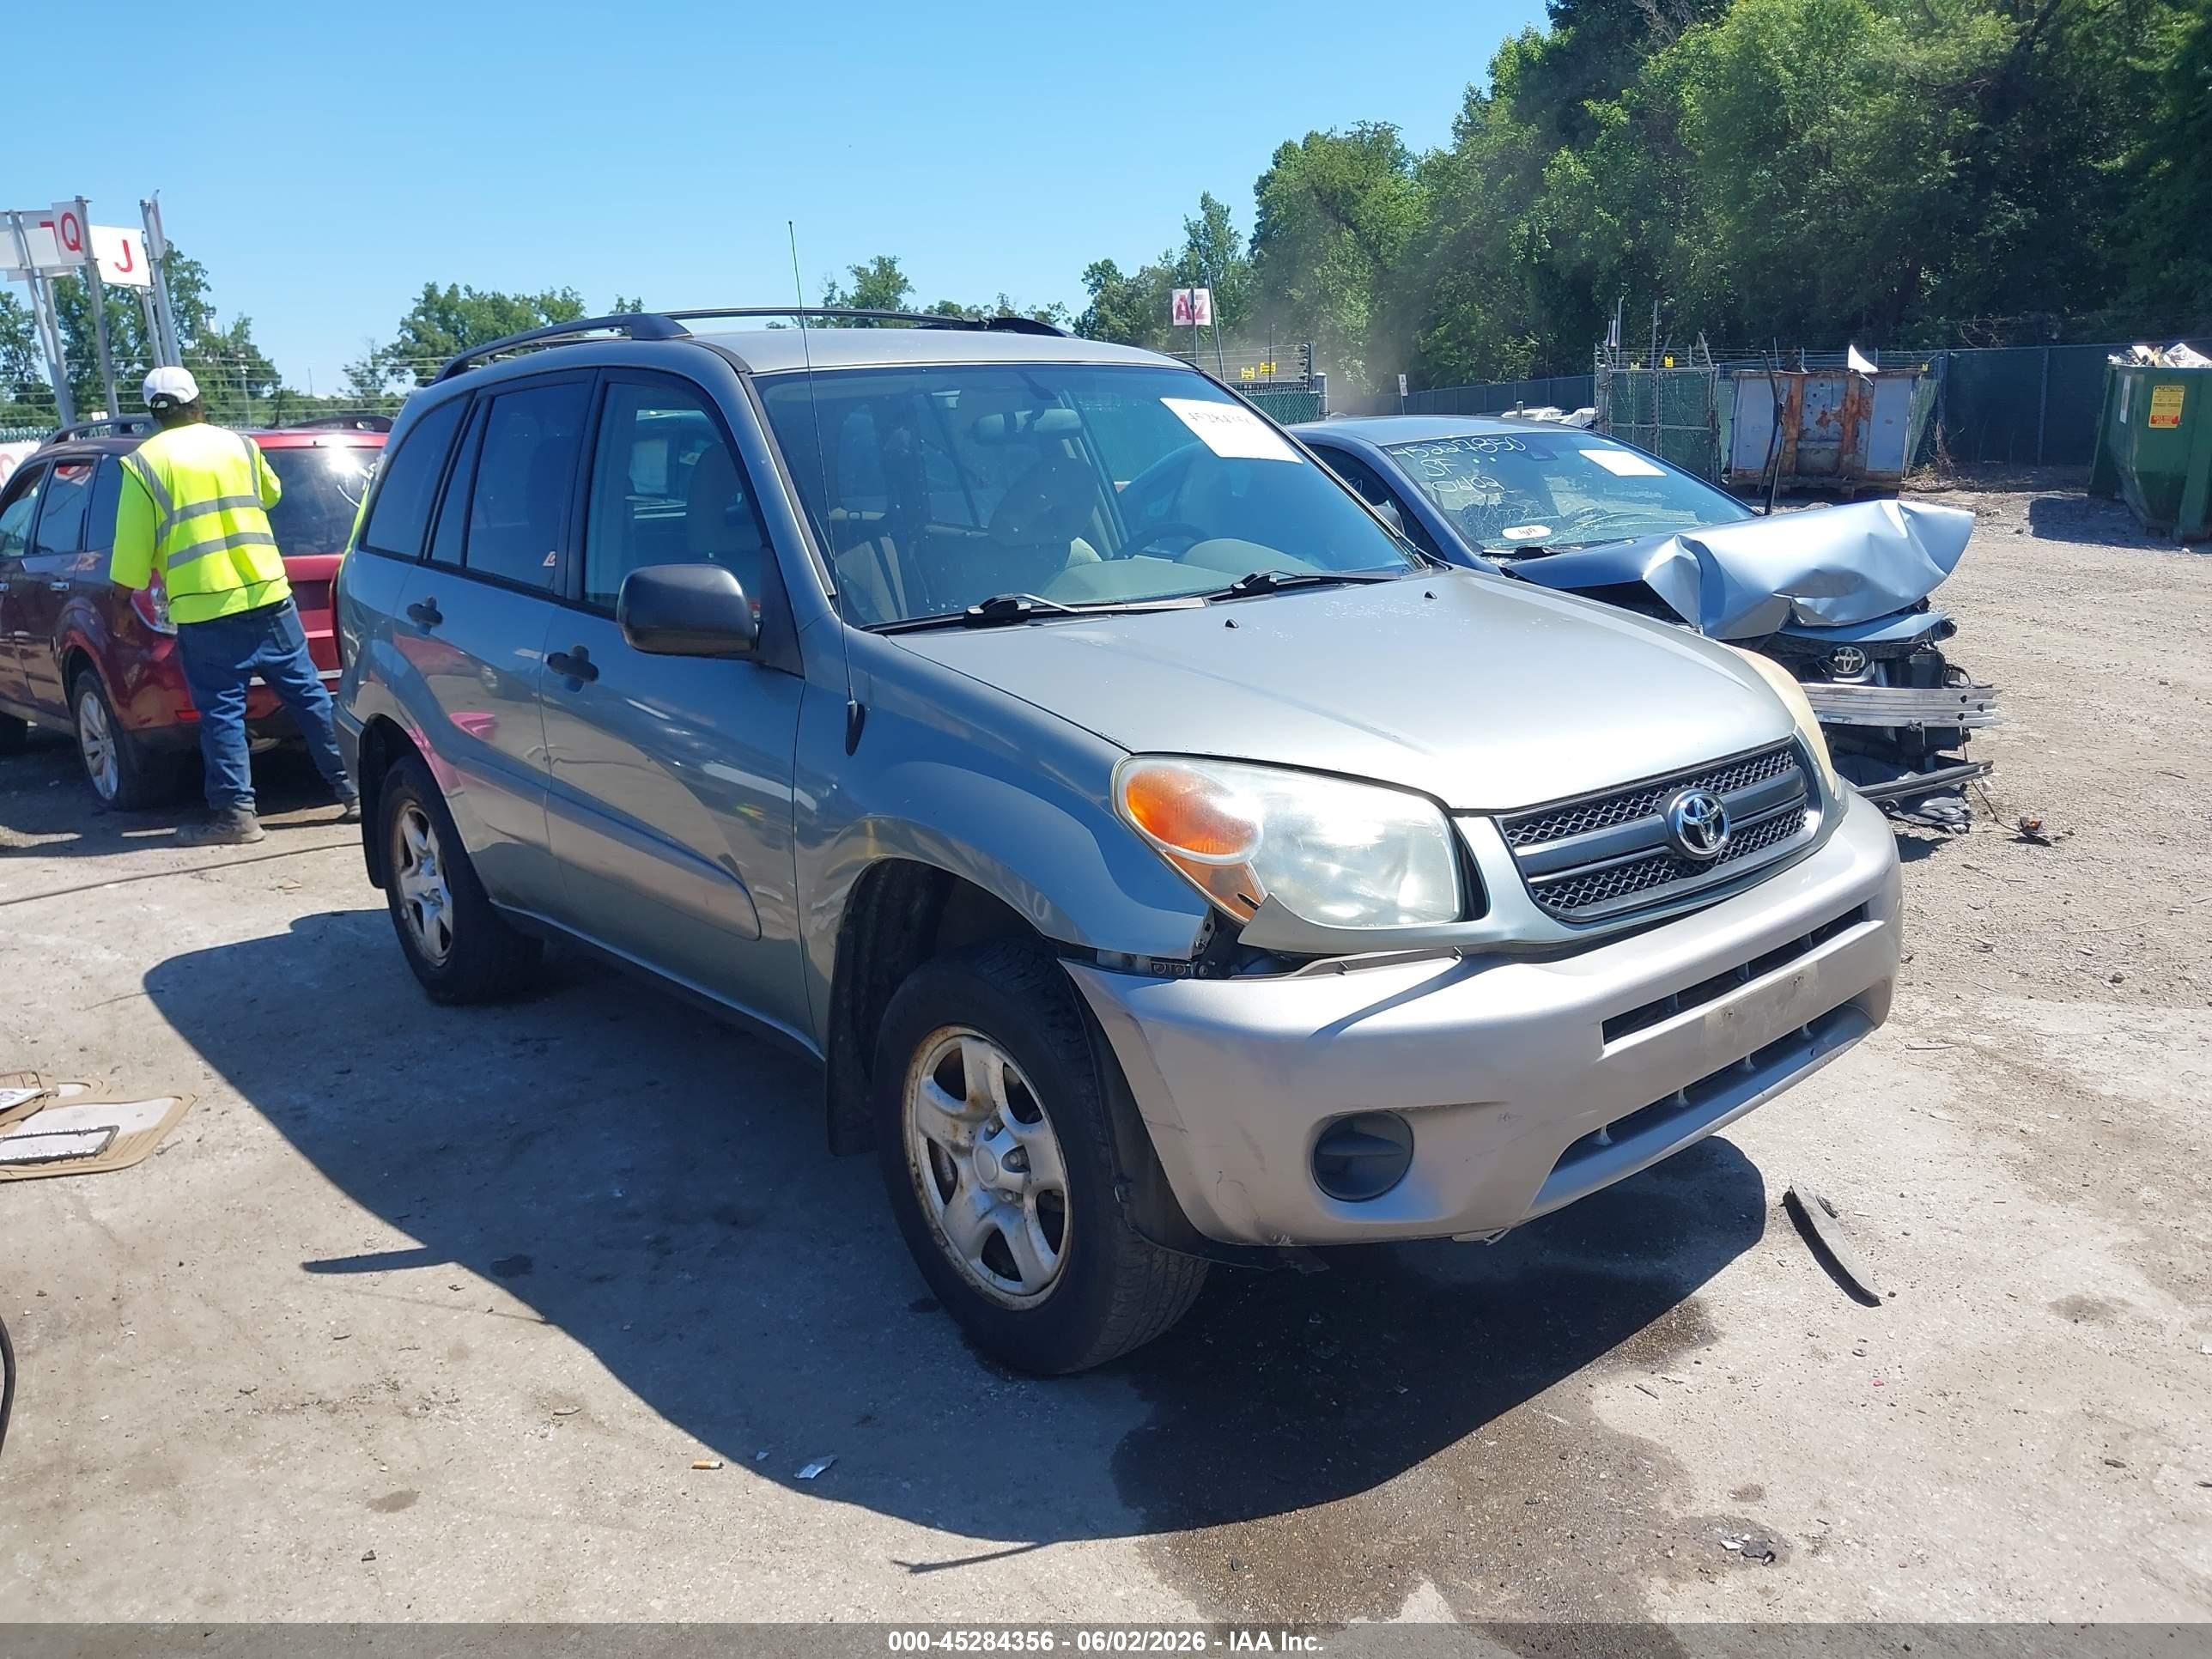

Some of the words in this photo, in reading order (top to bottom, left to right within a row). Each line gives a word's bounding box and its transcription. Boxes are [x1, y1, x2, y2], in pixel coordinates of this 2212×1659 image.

[60, 211, 83, 254] Q
[113, 240, 133, 273] J
[1384, 435, 1526, 459] 45227850
[1419, 458, 1459, 477] SF
[1431, 475, 1506, 493] 0402
